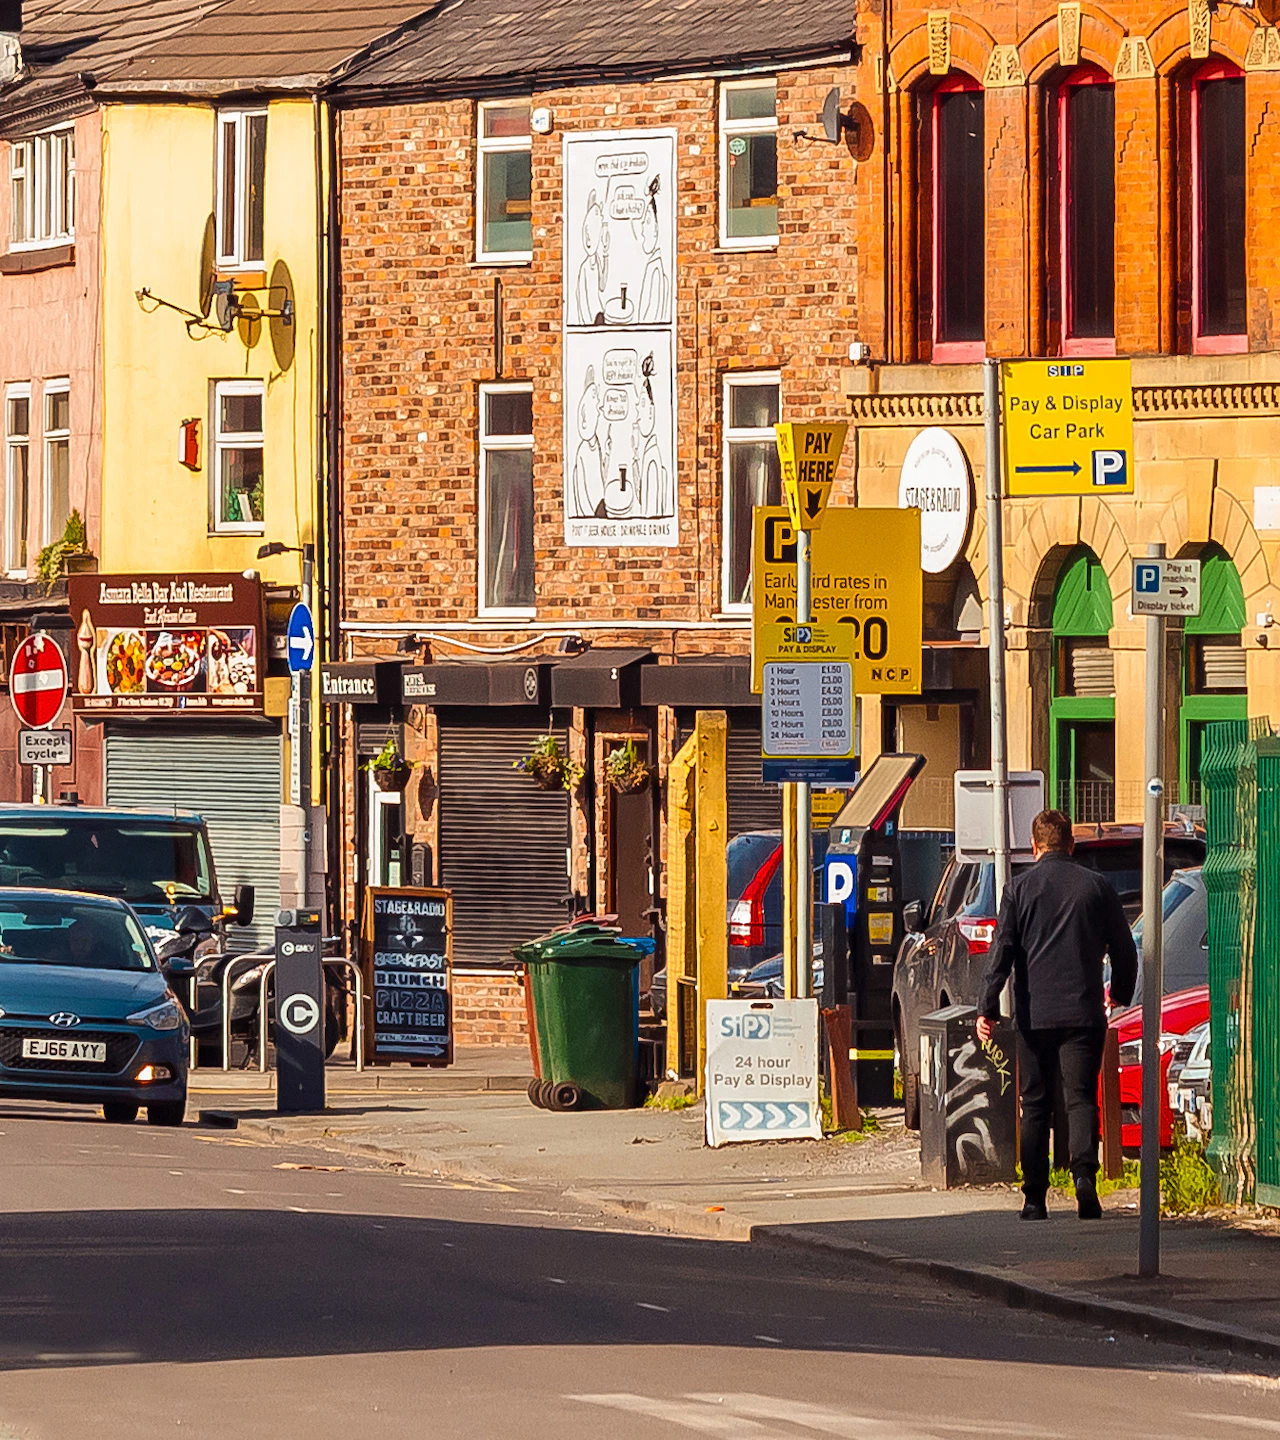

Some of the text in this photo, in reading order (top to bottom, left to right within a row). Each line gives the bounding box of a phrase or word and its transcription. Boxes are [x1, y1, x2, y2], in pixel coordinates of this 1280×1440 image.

[1048, 365, 1084, 377] SIP
[1010, 395, 1123, 415] Pay & Display
[1030, 423, 1105, 439] Car Park
[804, 431, 832, 454] PAY
[798, 460, 834, 483] HERE
[1095, 451, 1124, 485] P
[834, 575, 870, 589] rates
[874, 573, 887, 589] in
[1142, 569, 1155, 589] P
[1167, 563, 1182, 573] Pay
[1162, 575, 1196, 583] machine
[152, 582, 169, 603] Bar
[170, 581, 188, 602] And
[188, 581, 233, 602] Restaurant
[765, 594, 887, 610] Manester from
[1138, 601, 1194, 611] Display ticket
[771, 667, 774, 675] 1
[777, 667, 795, 675] Hour
[322, 671, 374, 695] Entrance
[771, 688, 775, 696] 3
[777, 688, 800, 696] Hours
[26, 735, 66, 747] Except
[771, 731, 779, 739] 24
[782, 731, 804, 739] Hours
[374, 900, 445, 916] STAGE&RADIO
[374, 951, 443, 969] BREAKFAST
[376, 973, 445, 987] BRUNCH
[375, 989, 445, 1010] PIZZA
[376, 1011, 446, 1027] CRAFT BEER
[29, 1041, 99, 1058] EJ66 AYY
[735, 1056, 790, 1068] 24 hour
[714, 1073, 812, 1088] Pay & Display
